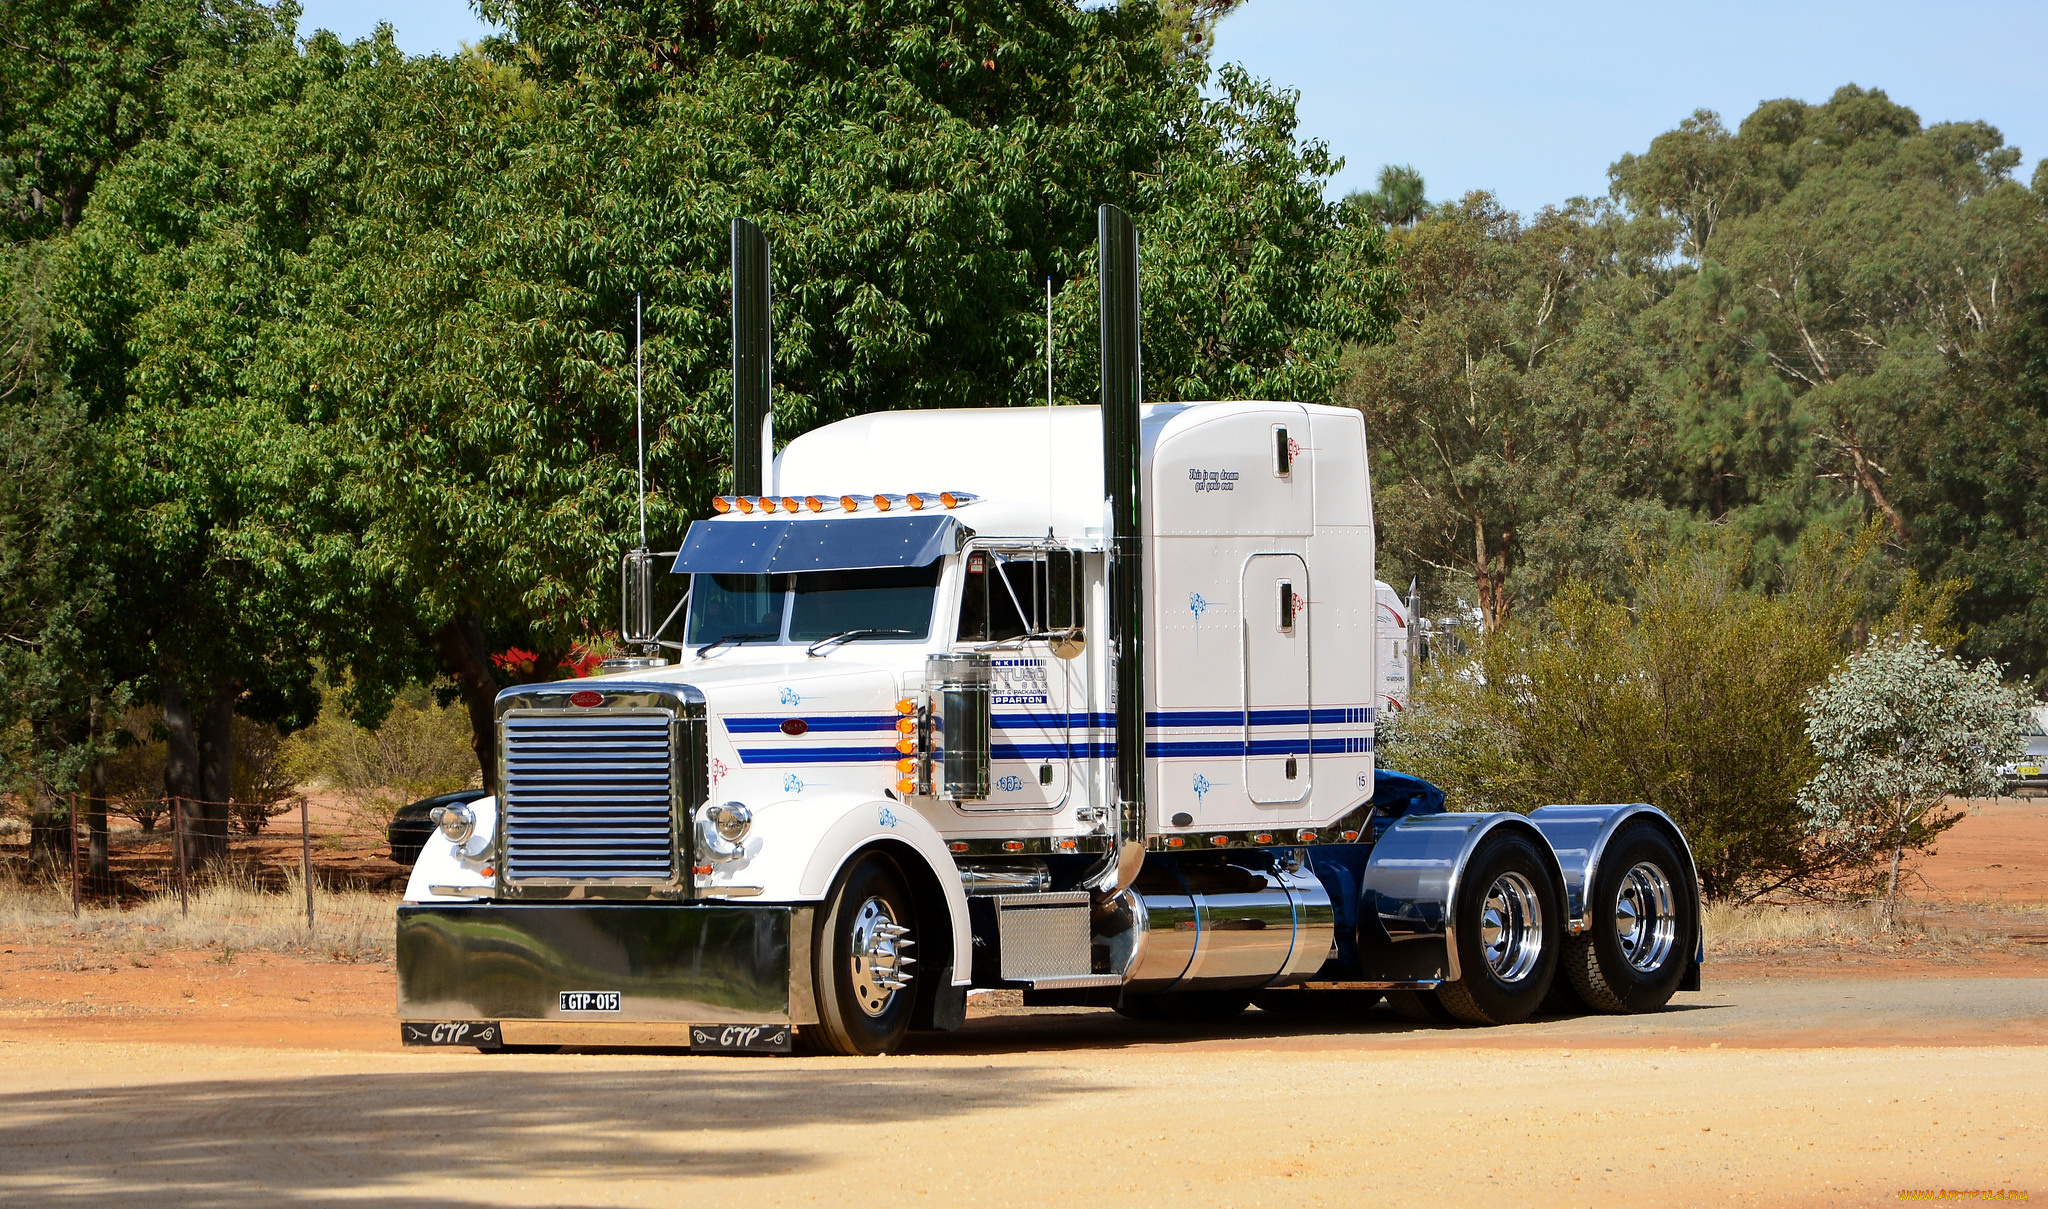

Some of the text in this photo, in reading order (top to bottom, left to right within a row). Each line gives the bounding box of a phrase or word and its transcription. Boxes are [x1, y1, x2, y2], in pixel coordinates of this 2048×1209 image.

[1189, 469, 1202, 480] This
[1220, 469, 1239, 480] dream
[1358, 775, 1366, 787] 15
[431, 1023, 469, 1042] GTP
[720, 1027, 760, 1046] GTP
